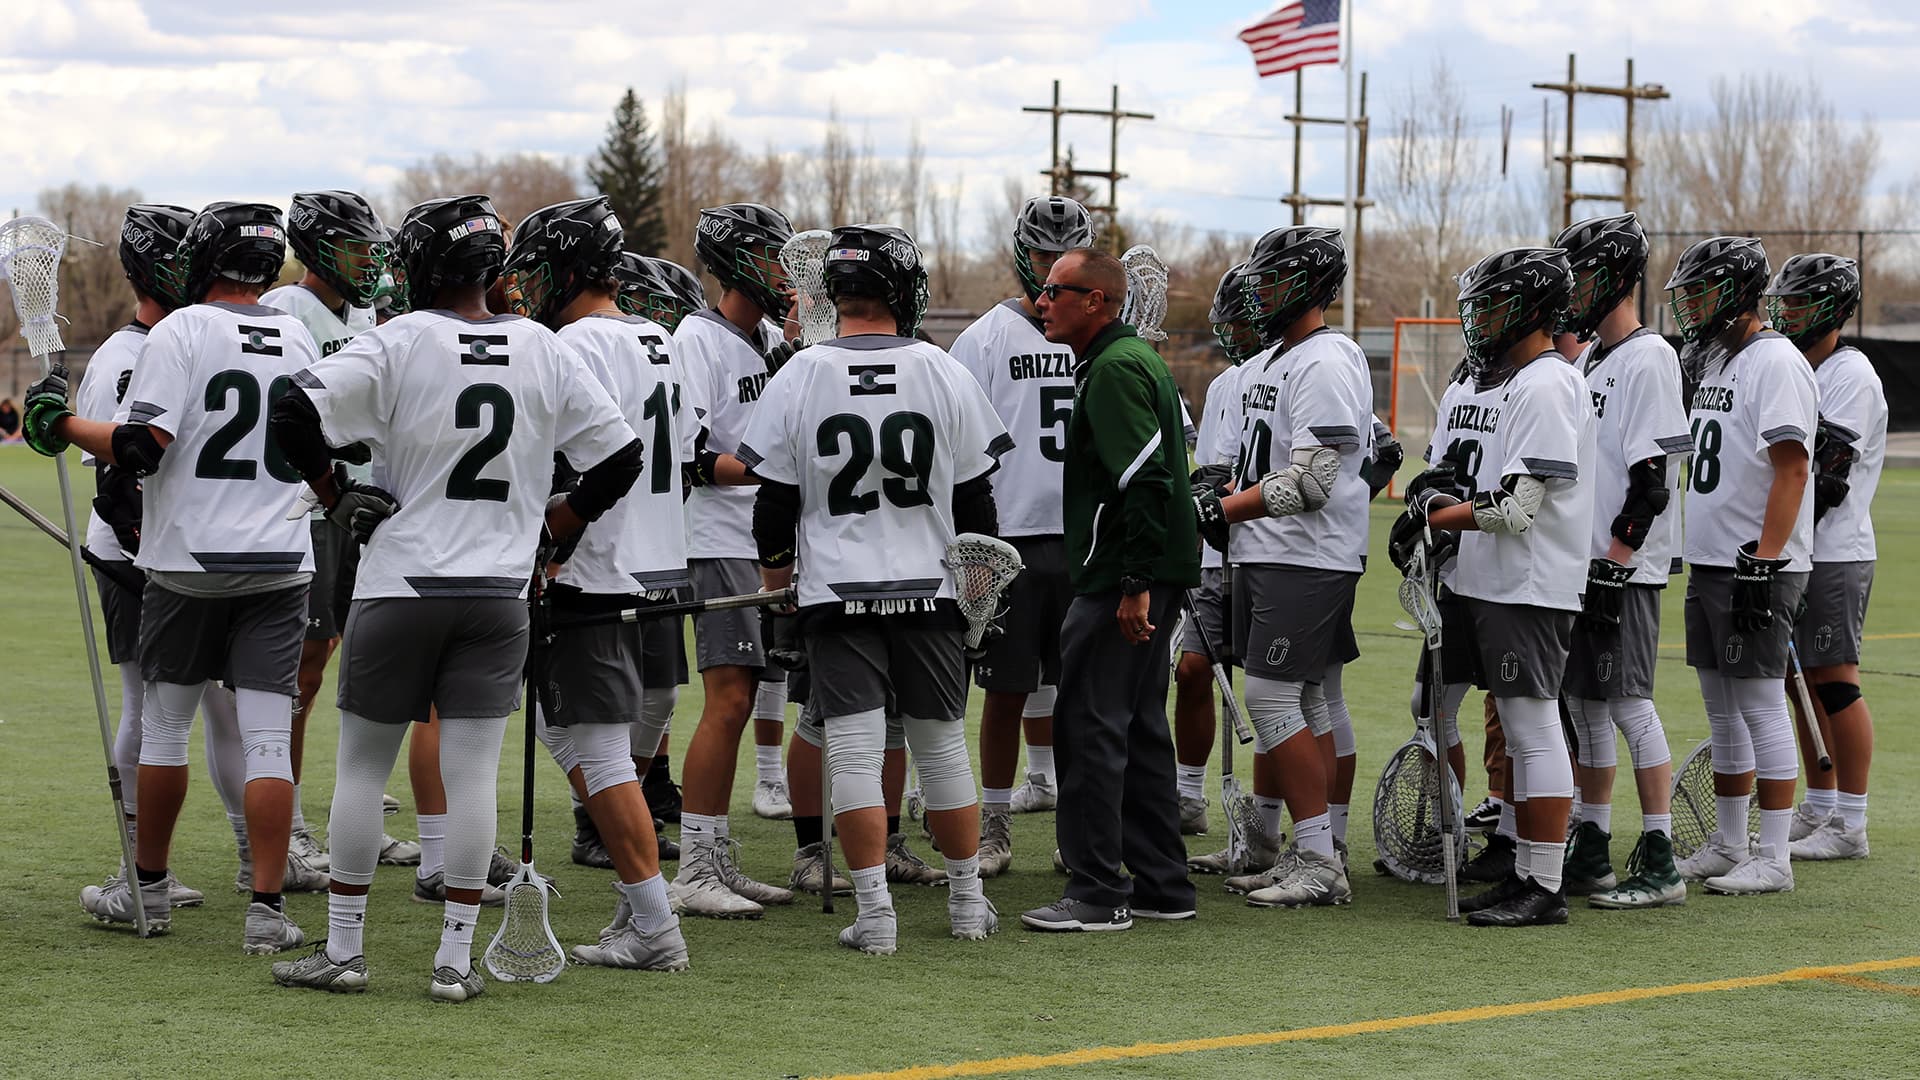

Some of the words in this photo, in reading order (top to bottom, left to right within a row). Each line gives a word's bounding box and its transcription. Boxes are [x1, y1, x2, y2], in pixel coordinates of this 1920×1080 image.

[856, 249, 870, 262] 20
[879, 239, 916, 271] ASU
[1009, 353, 1075, 380] GRIZZL
[1039, 386, 1075, 462] 5
[446, 382, 515, 502] 2
[816, 410, 936, 517] 29
[1591, 577, 1623, 589] ARMOUR
